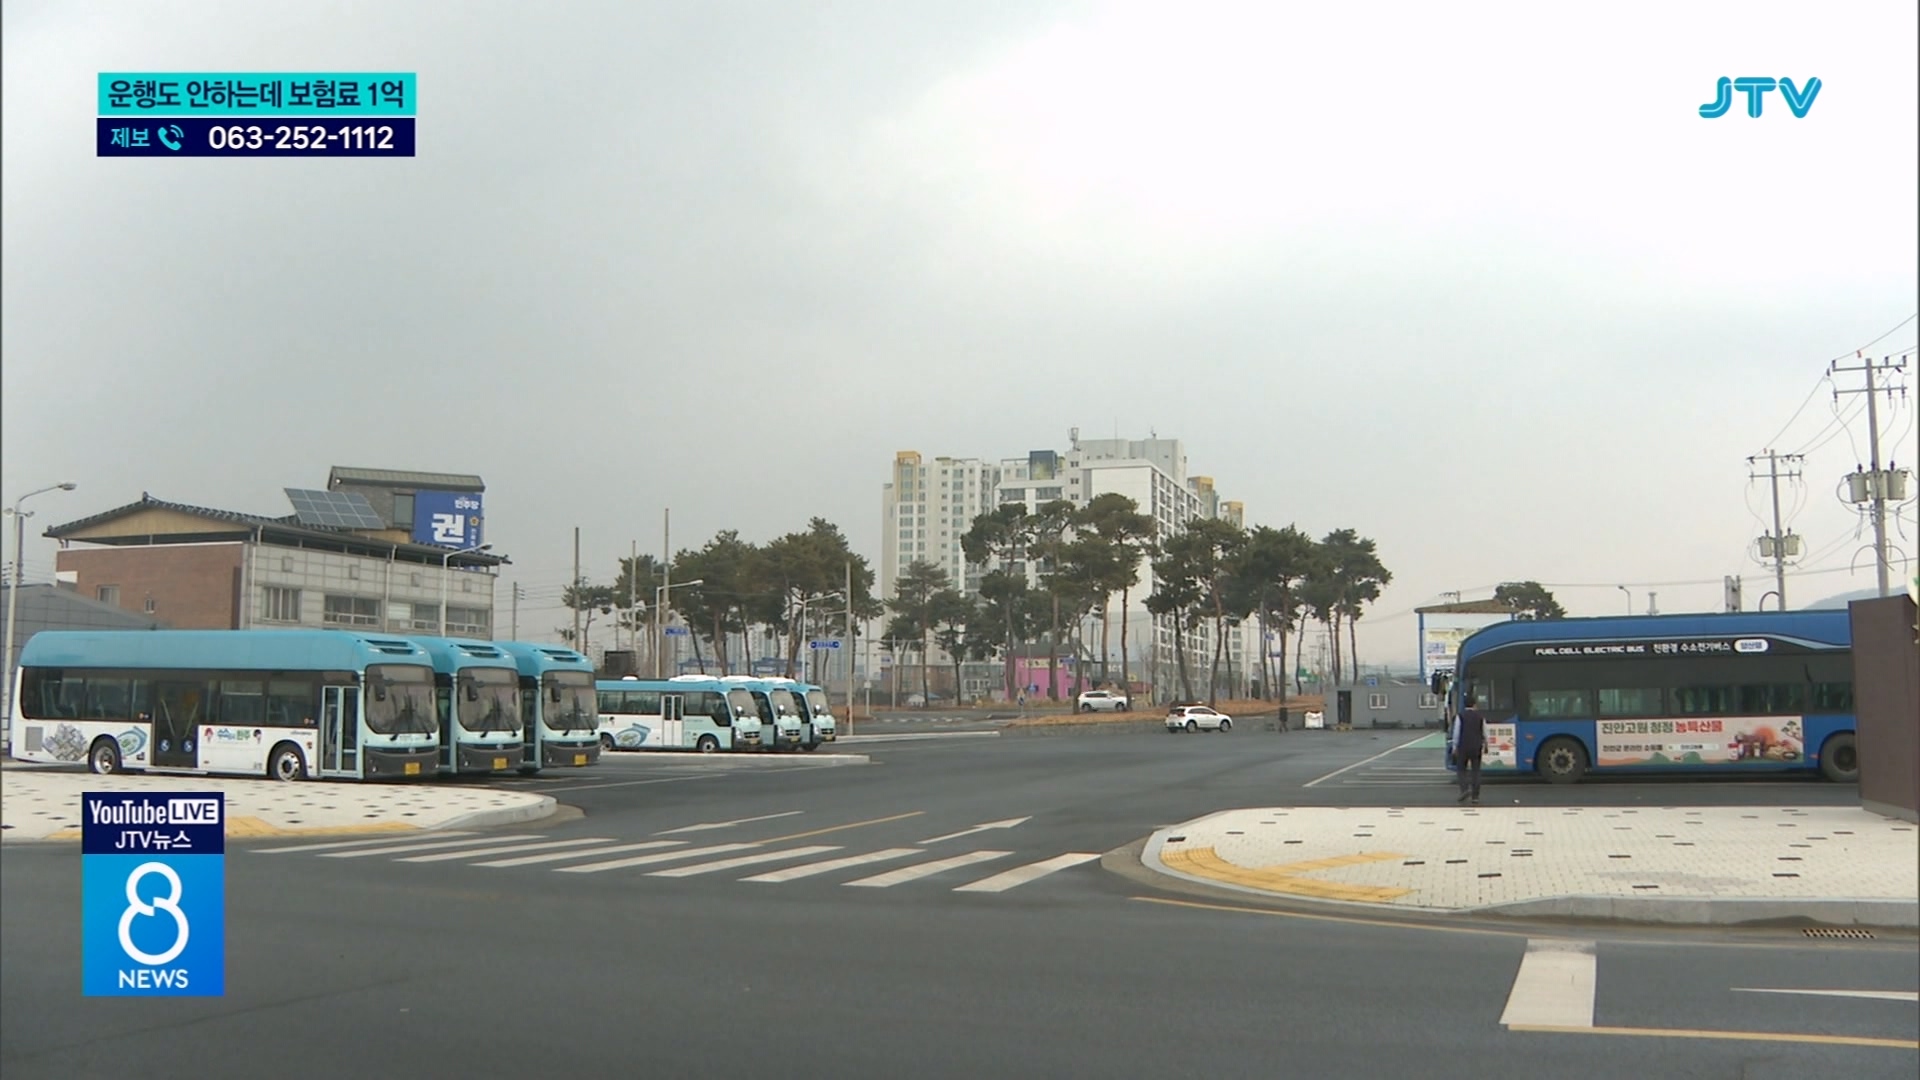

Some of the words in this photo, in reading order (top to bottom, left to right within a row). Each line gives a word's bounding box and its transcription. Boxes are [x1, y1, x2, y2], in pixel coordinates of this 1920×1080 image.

[431, 513, 465, 544] 권
[1535, 648, 1558, 656] FUEL
[1559, 647, 1582, 655] CELL
[1583, 646, 1625, 654] ELECTRIC
[1626, 645, 1645, 653] BUS
[1680, 642, 1731, 653] 수소전기버스
[1601, 721, 1649, 734] 진안고원
[1650, 721, 1673, 734] 청정
[1675, 720, 1723, 733] 농특산물
